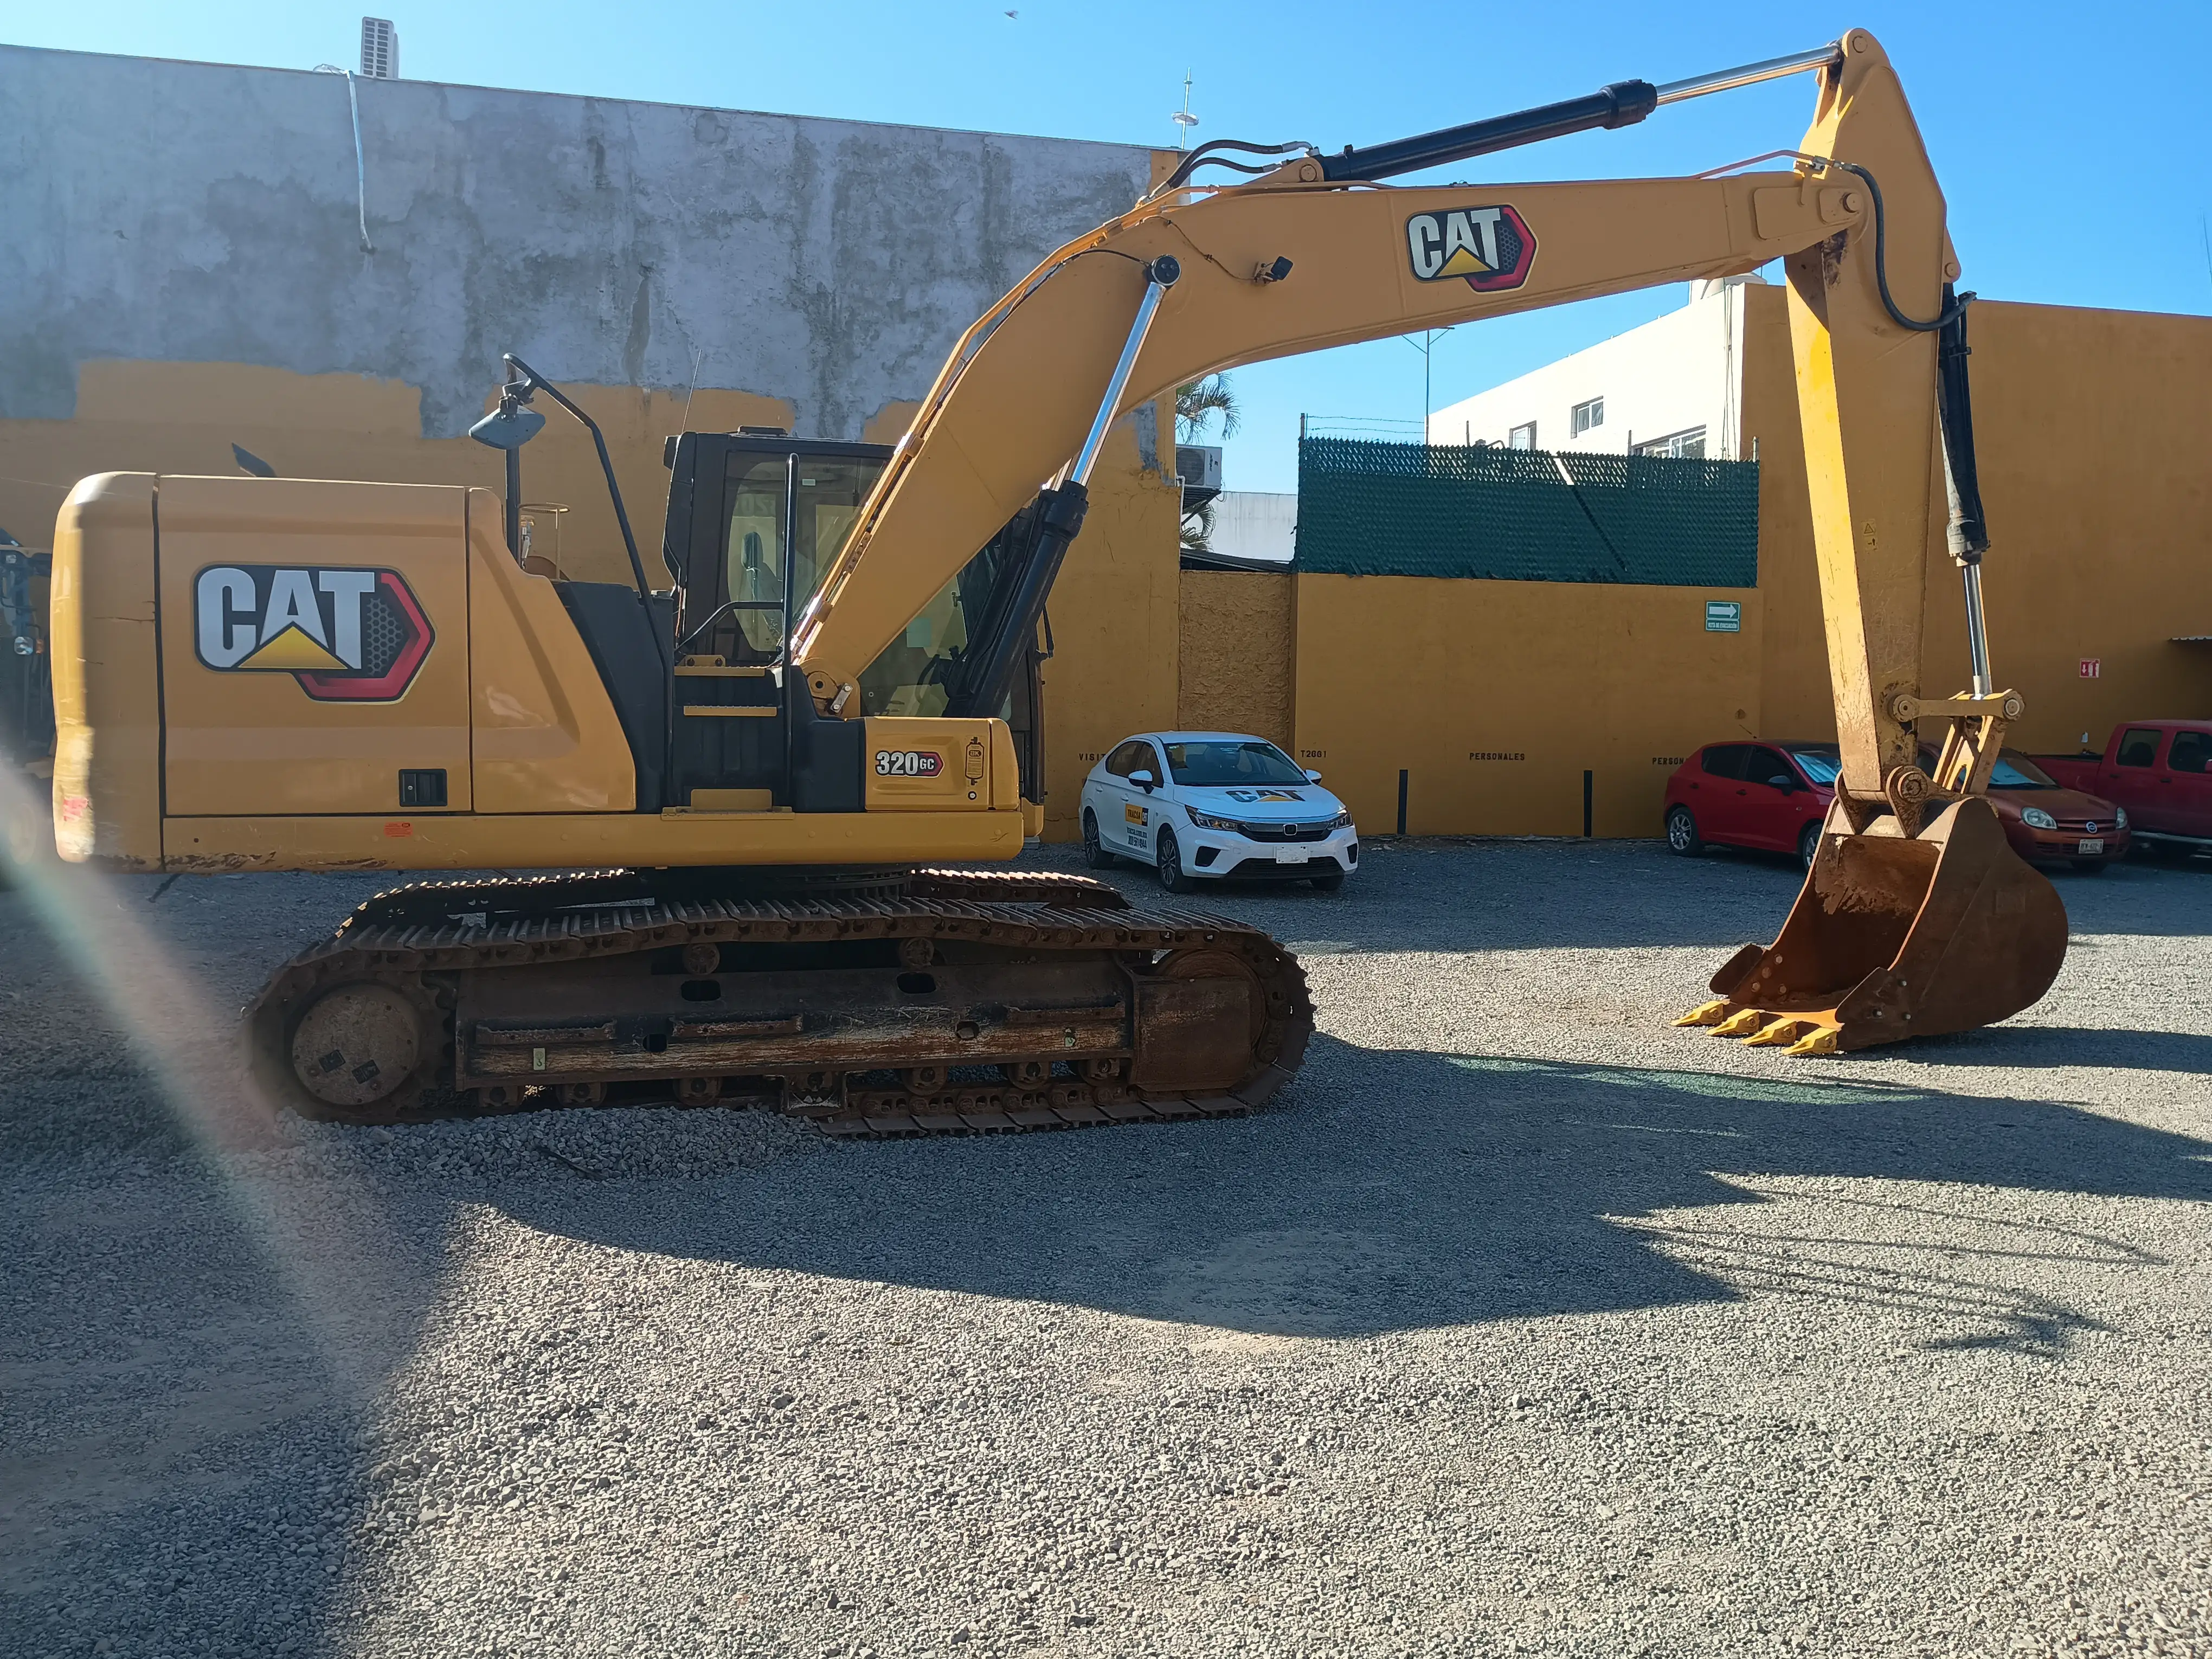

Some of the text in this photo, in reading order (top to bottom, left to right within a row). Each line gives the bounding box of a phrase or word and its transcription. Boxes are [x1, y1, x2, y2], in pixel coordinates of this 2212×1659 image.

[1409, 208, 1501, 278] CAT
[198, 568, 375, 670] CAT
[877, 752, 935, 774] 320 GC
[1469, 753, 1525, 761] PERSONALES
[1225, 790, 1306, 802] CAT
